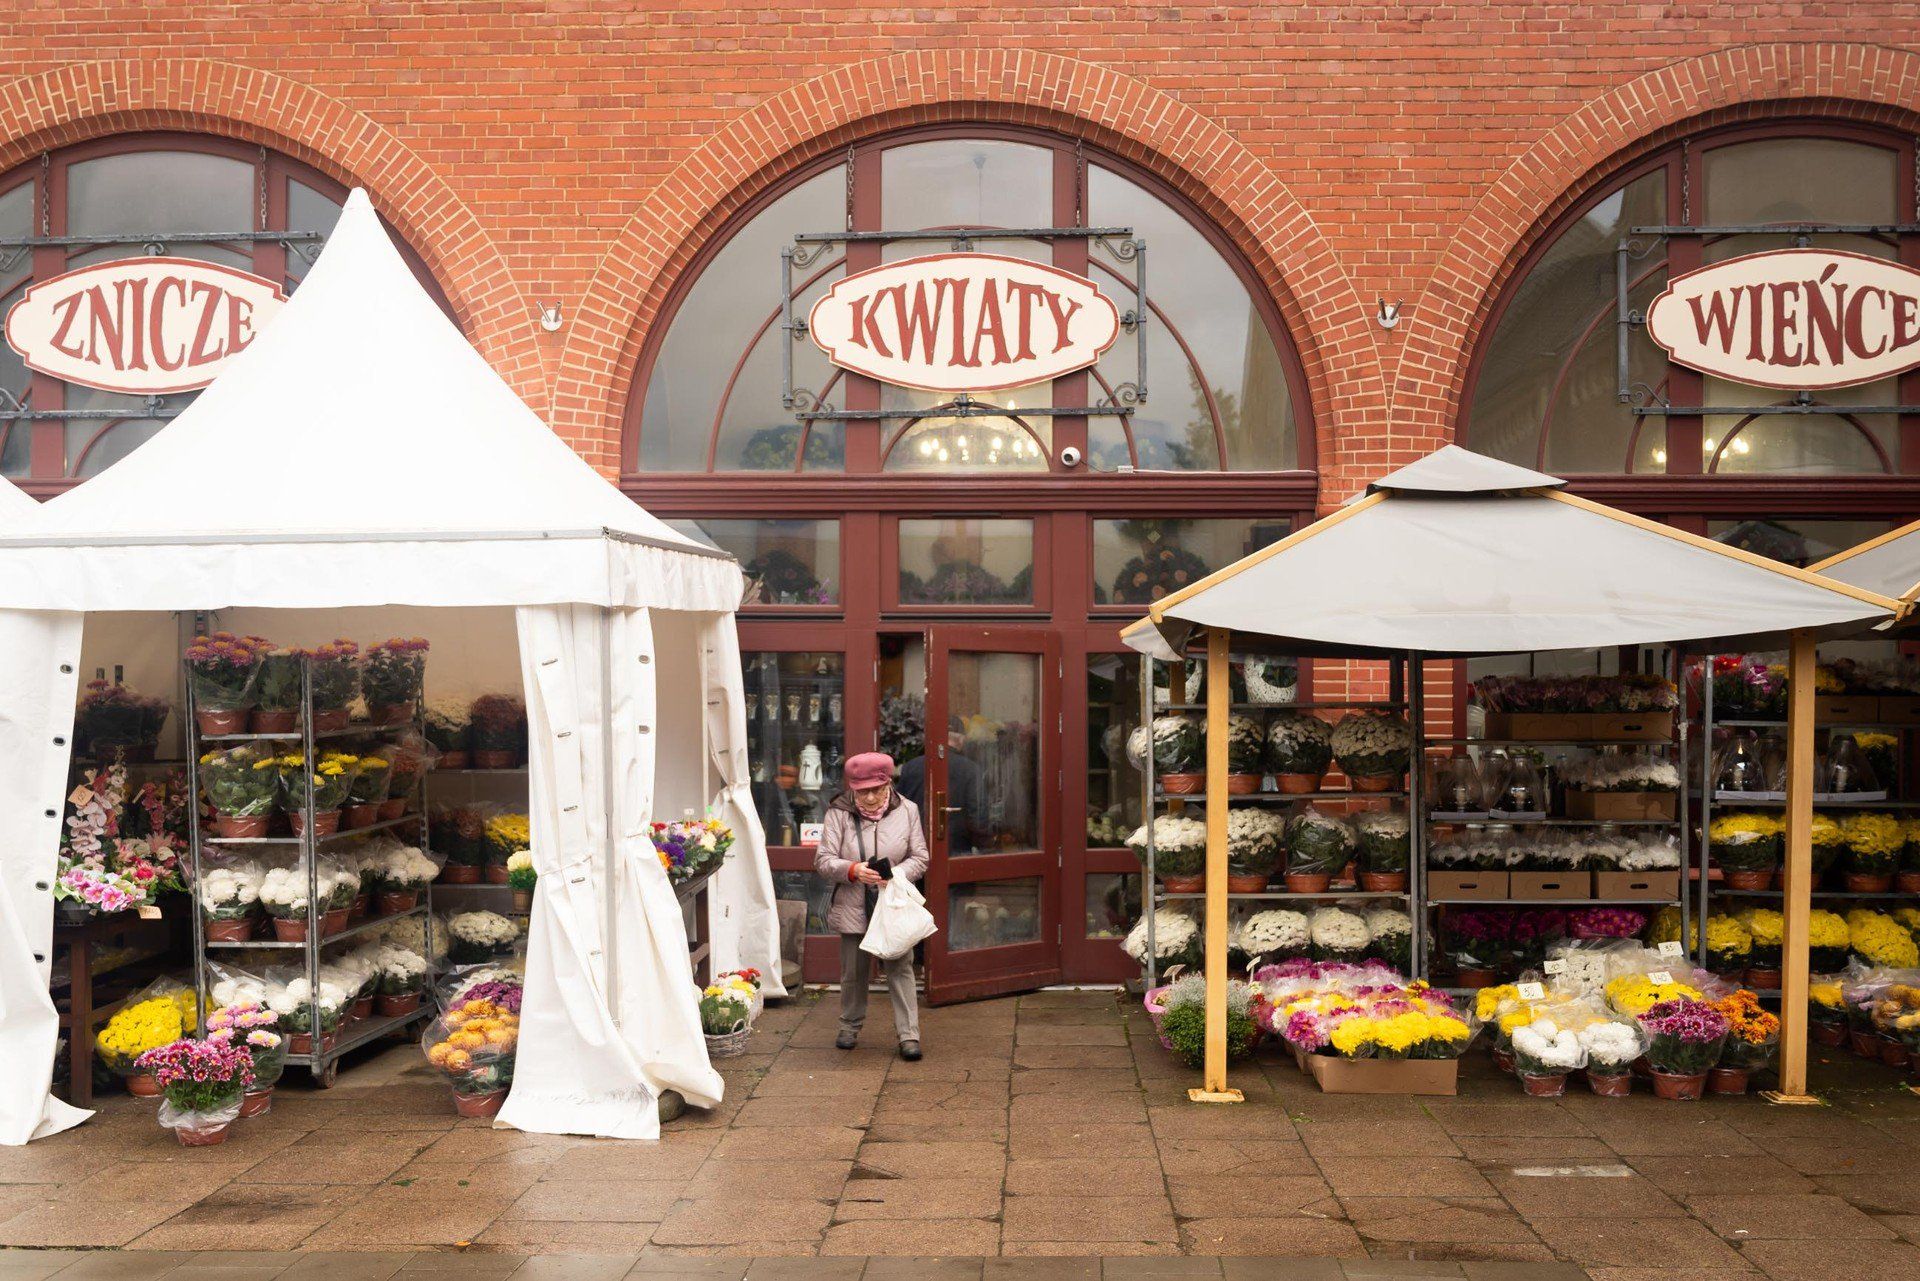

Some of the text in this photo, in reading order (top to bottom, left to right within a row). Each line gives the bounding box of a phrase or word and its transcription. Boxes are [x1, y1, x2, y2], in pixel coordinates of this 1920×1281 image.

[50, 276, 256, 372] ZNICZE
[847, 278, 1083, 368] KWIATY
[1685, 263, 1920, 368] WIEŃCE
